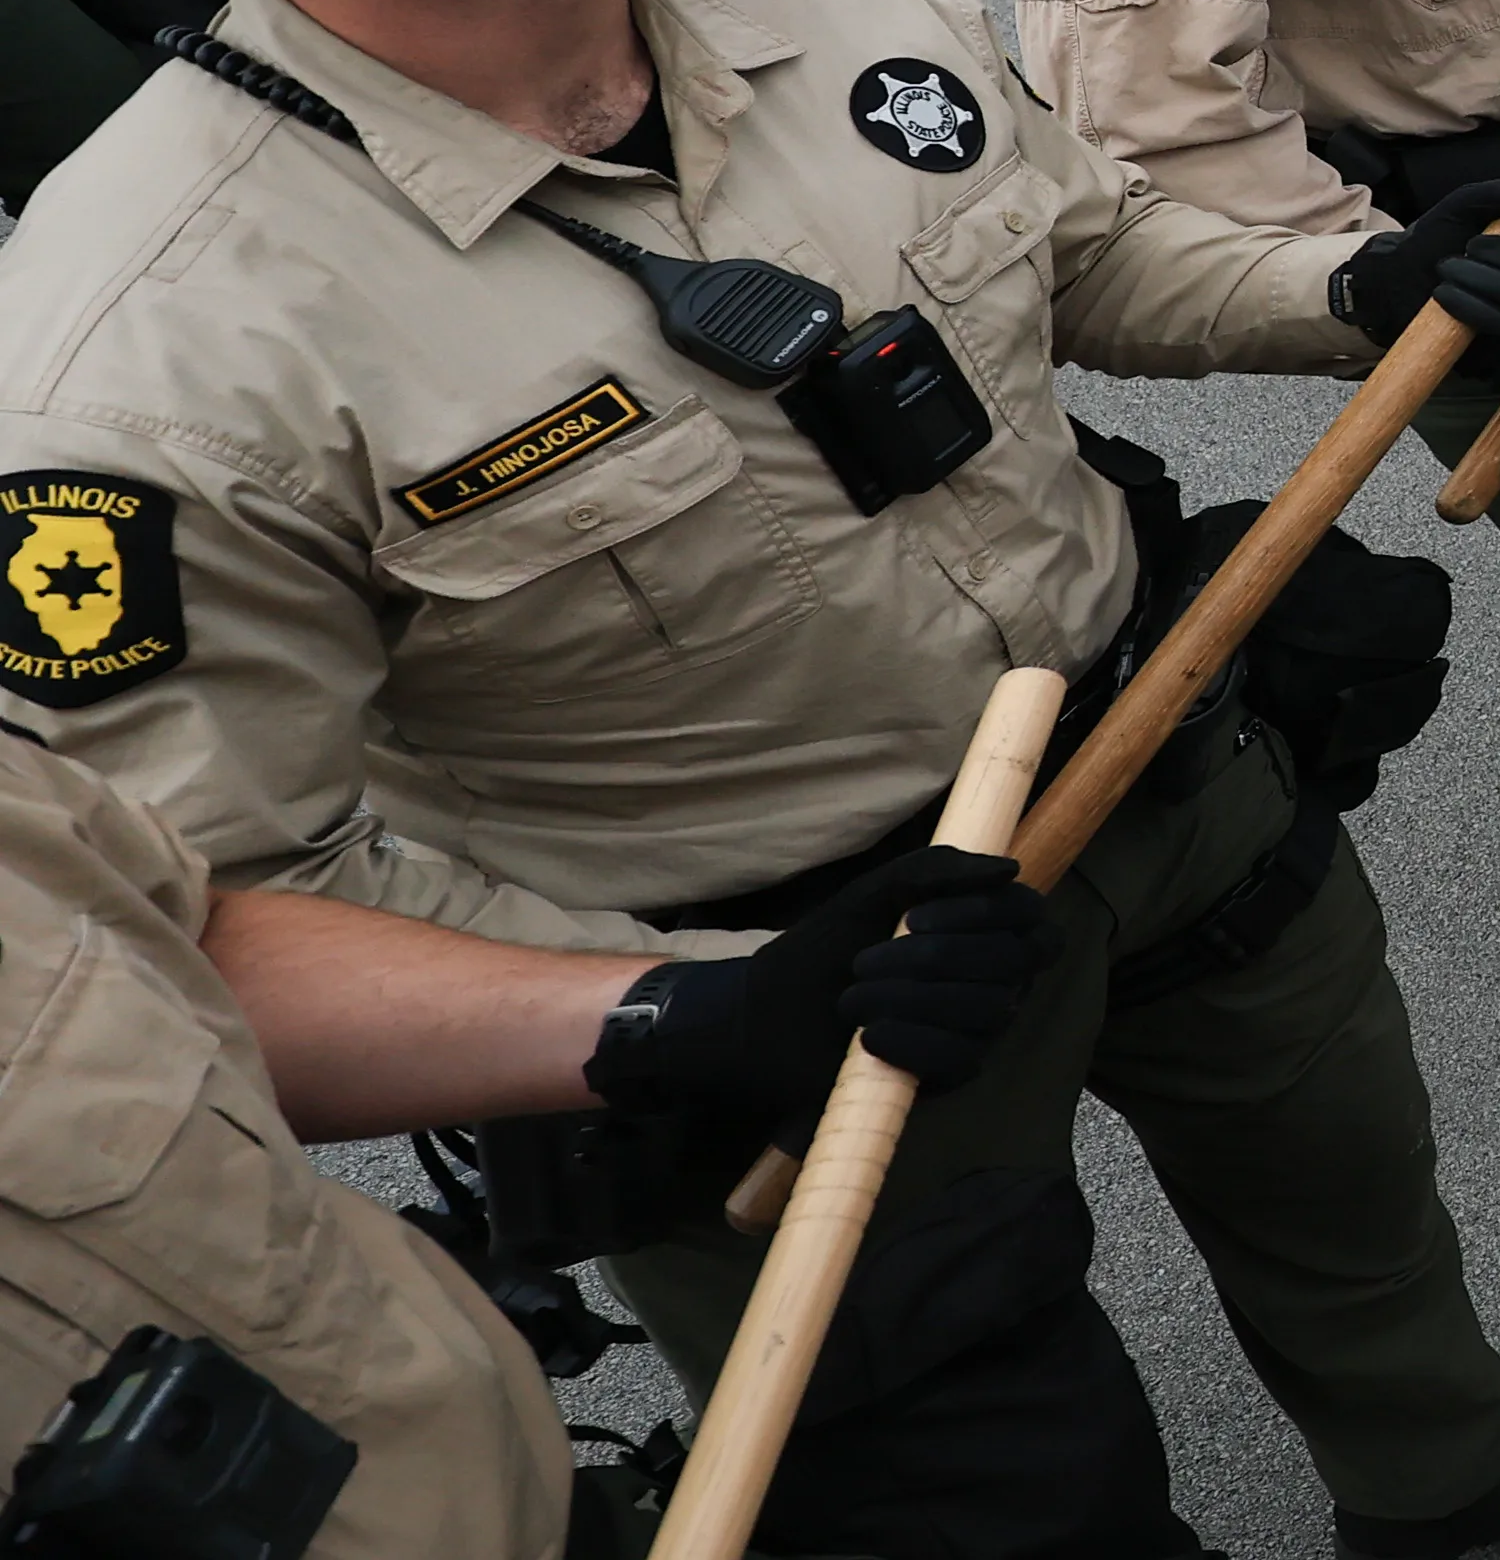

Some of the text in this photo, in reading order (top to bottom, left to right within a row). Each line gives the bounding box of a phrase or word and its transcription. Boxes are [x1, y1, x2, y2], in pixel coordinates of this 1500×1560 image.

[895, 90, 931, 116] ILLINOIS
[906, 120, 933, 138] STATE
[772, 322, 814, 363] MOTOROLA
[456, 411, 602, 497] J. HINOJOSA
[0, 484, 140, 520] ILLINOIS
[71, 636, 170, 678] POLICE
